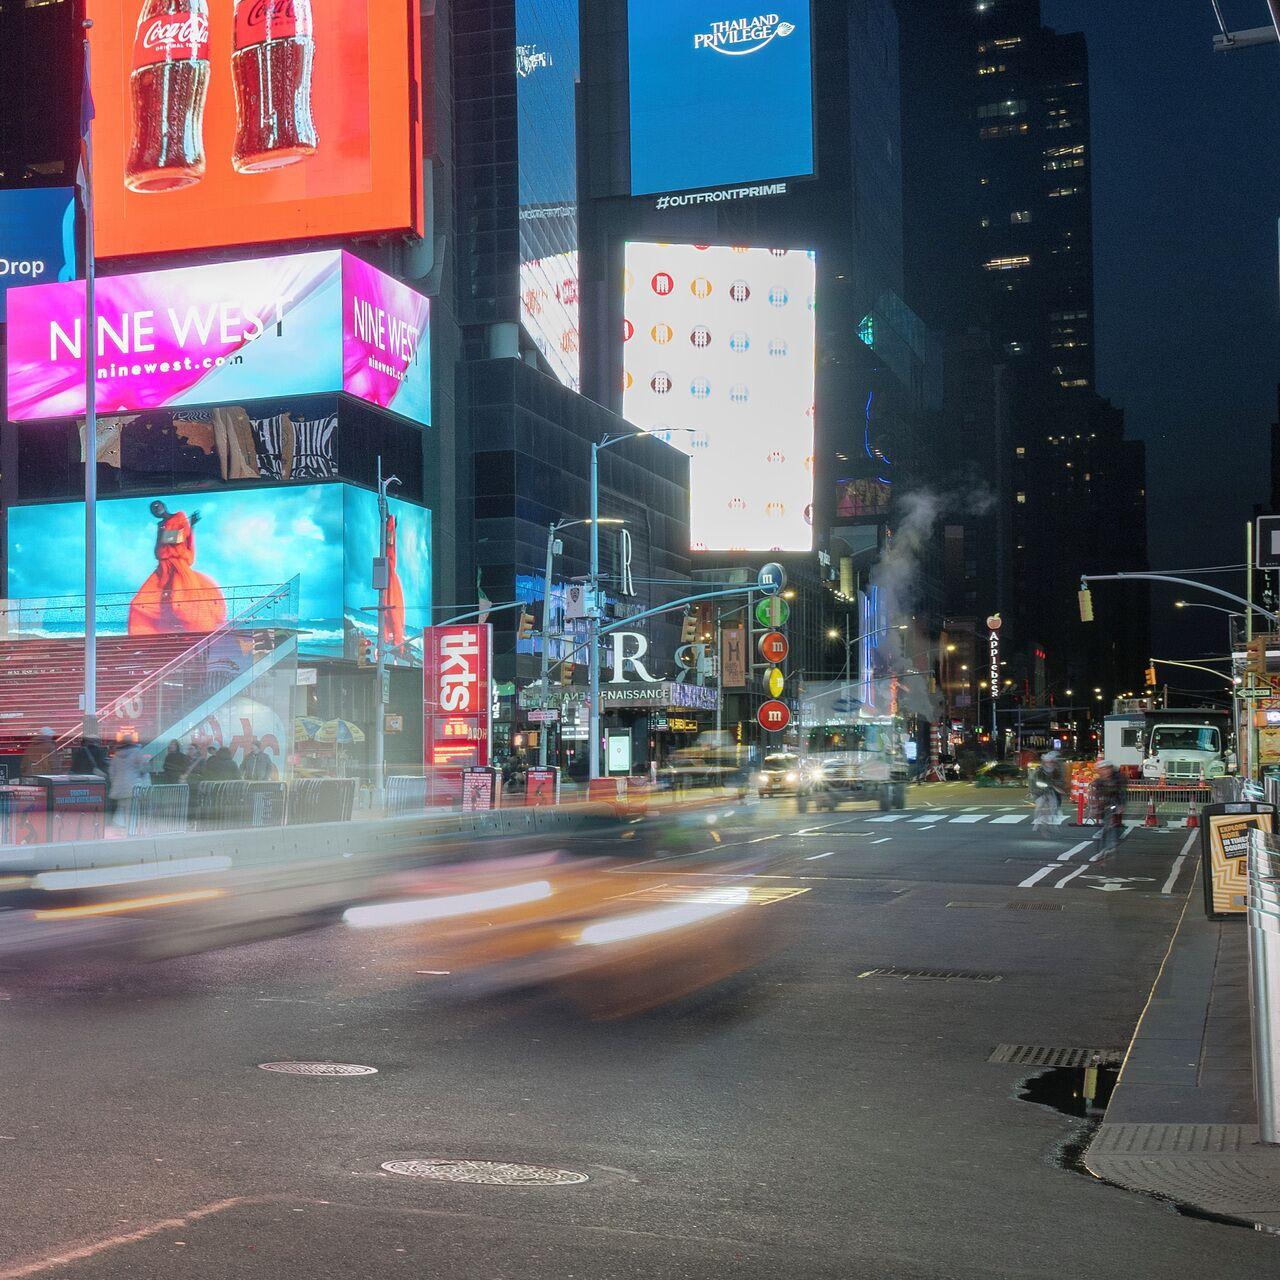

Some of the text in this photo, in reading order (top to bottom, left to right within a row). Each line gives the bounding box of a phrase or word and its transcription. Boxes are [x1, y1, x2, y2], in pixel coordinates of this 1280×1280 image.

[693, 24, 773, 50] PRIVILEGE
[710, 13, 779, 36] THAILAND
[655, 182, 786, 212] #OUTFRONTPRIME
[168, 294, 293, 349] WEST
[353, 296, 420, 366] NINE WEST
[439, 630, 478, 711] tkts
[609, 631, 666, 684] R
[768, 709, 782, 721] m
